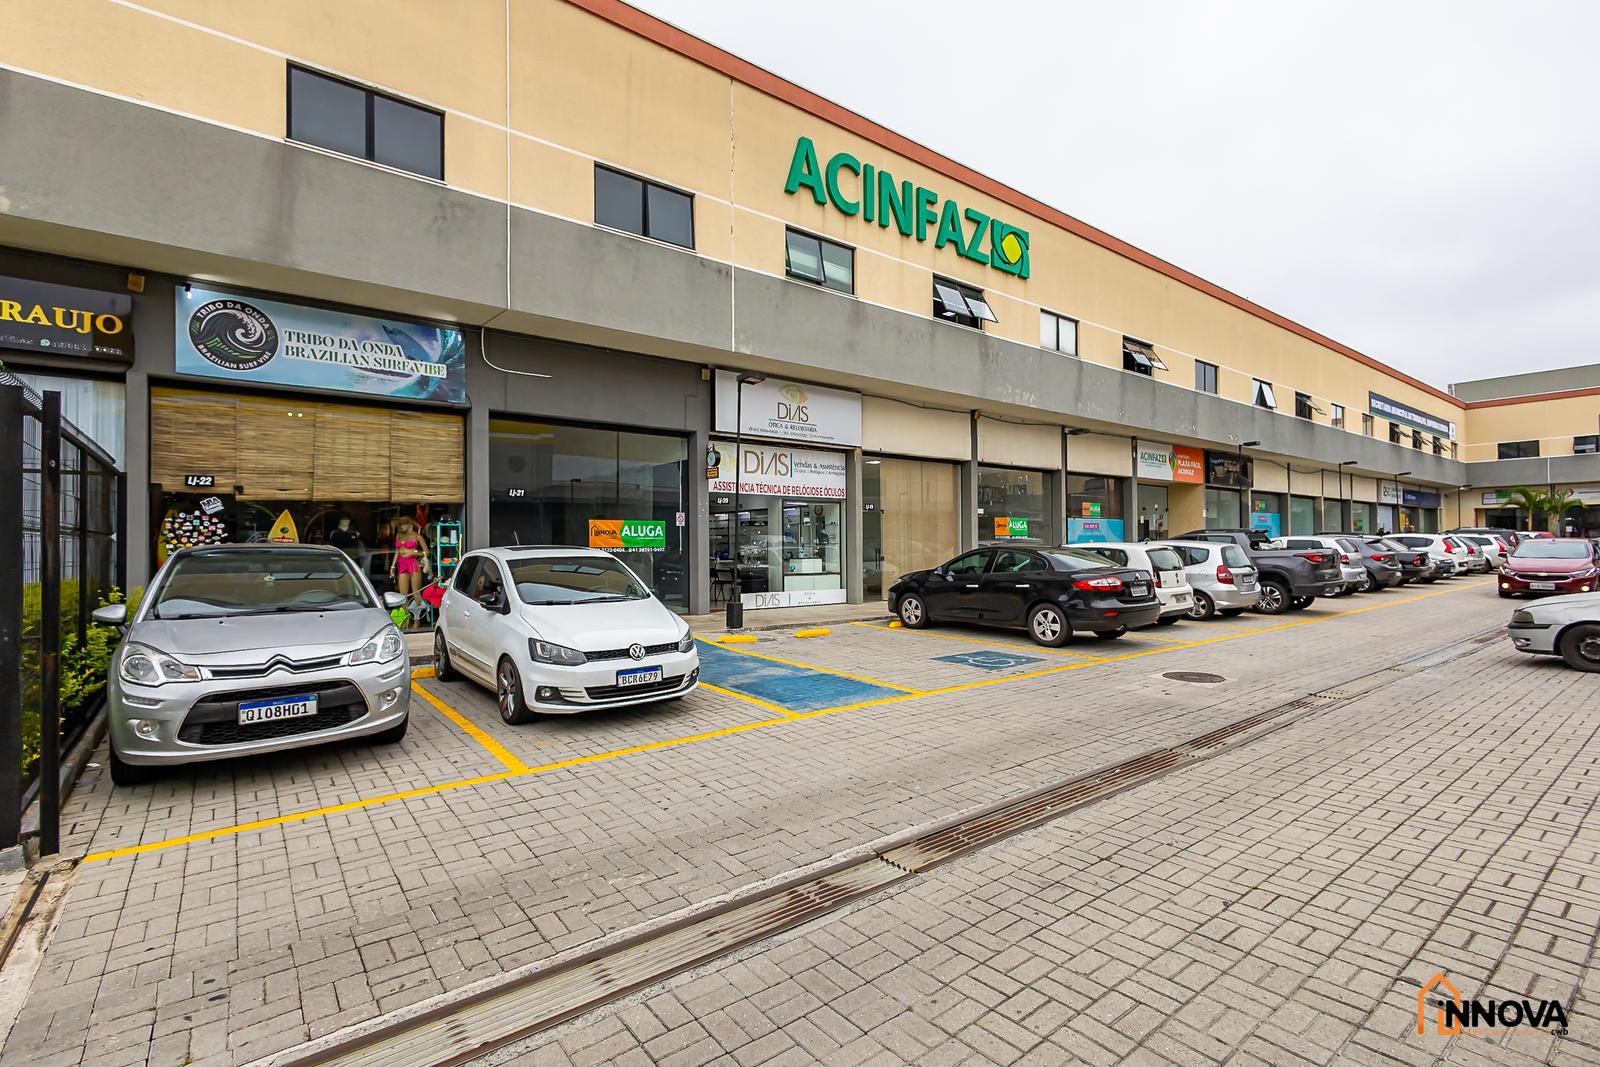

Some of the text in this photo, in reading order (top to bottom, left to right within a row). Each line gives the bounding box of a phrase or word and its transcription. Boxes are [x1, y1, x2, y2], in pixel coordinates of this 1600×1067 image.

[784, 136, 990, 266] ACINFAZ
[0, 299, 123, 334] RAUJO
[196, 302, 270, 329] TRIBO DA ONDA
[197, 344, 272, 369] BRAZILIAN SURF VIBE
[284, 330, 403, 357] TRIBO DA ONDA
[284, 345, 446, 376] BRAZILIAN SURF VIBE
[713, 481, 755, 493] ASSISTNCIA
[756, 482, 782, 495] TÉCNICA
[783, 486, 791, 495] DE
[824, 486, 845, 497] ÓCULOS
[621, 525, 664, 537] ALUGA
[1008, 520, 1028, 529] ALUGA
[621, 672, 658, 685] BCR6E79
